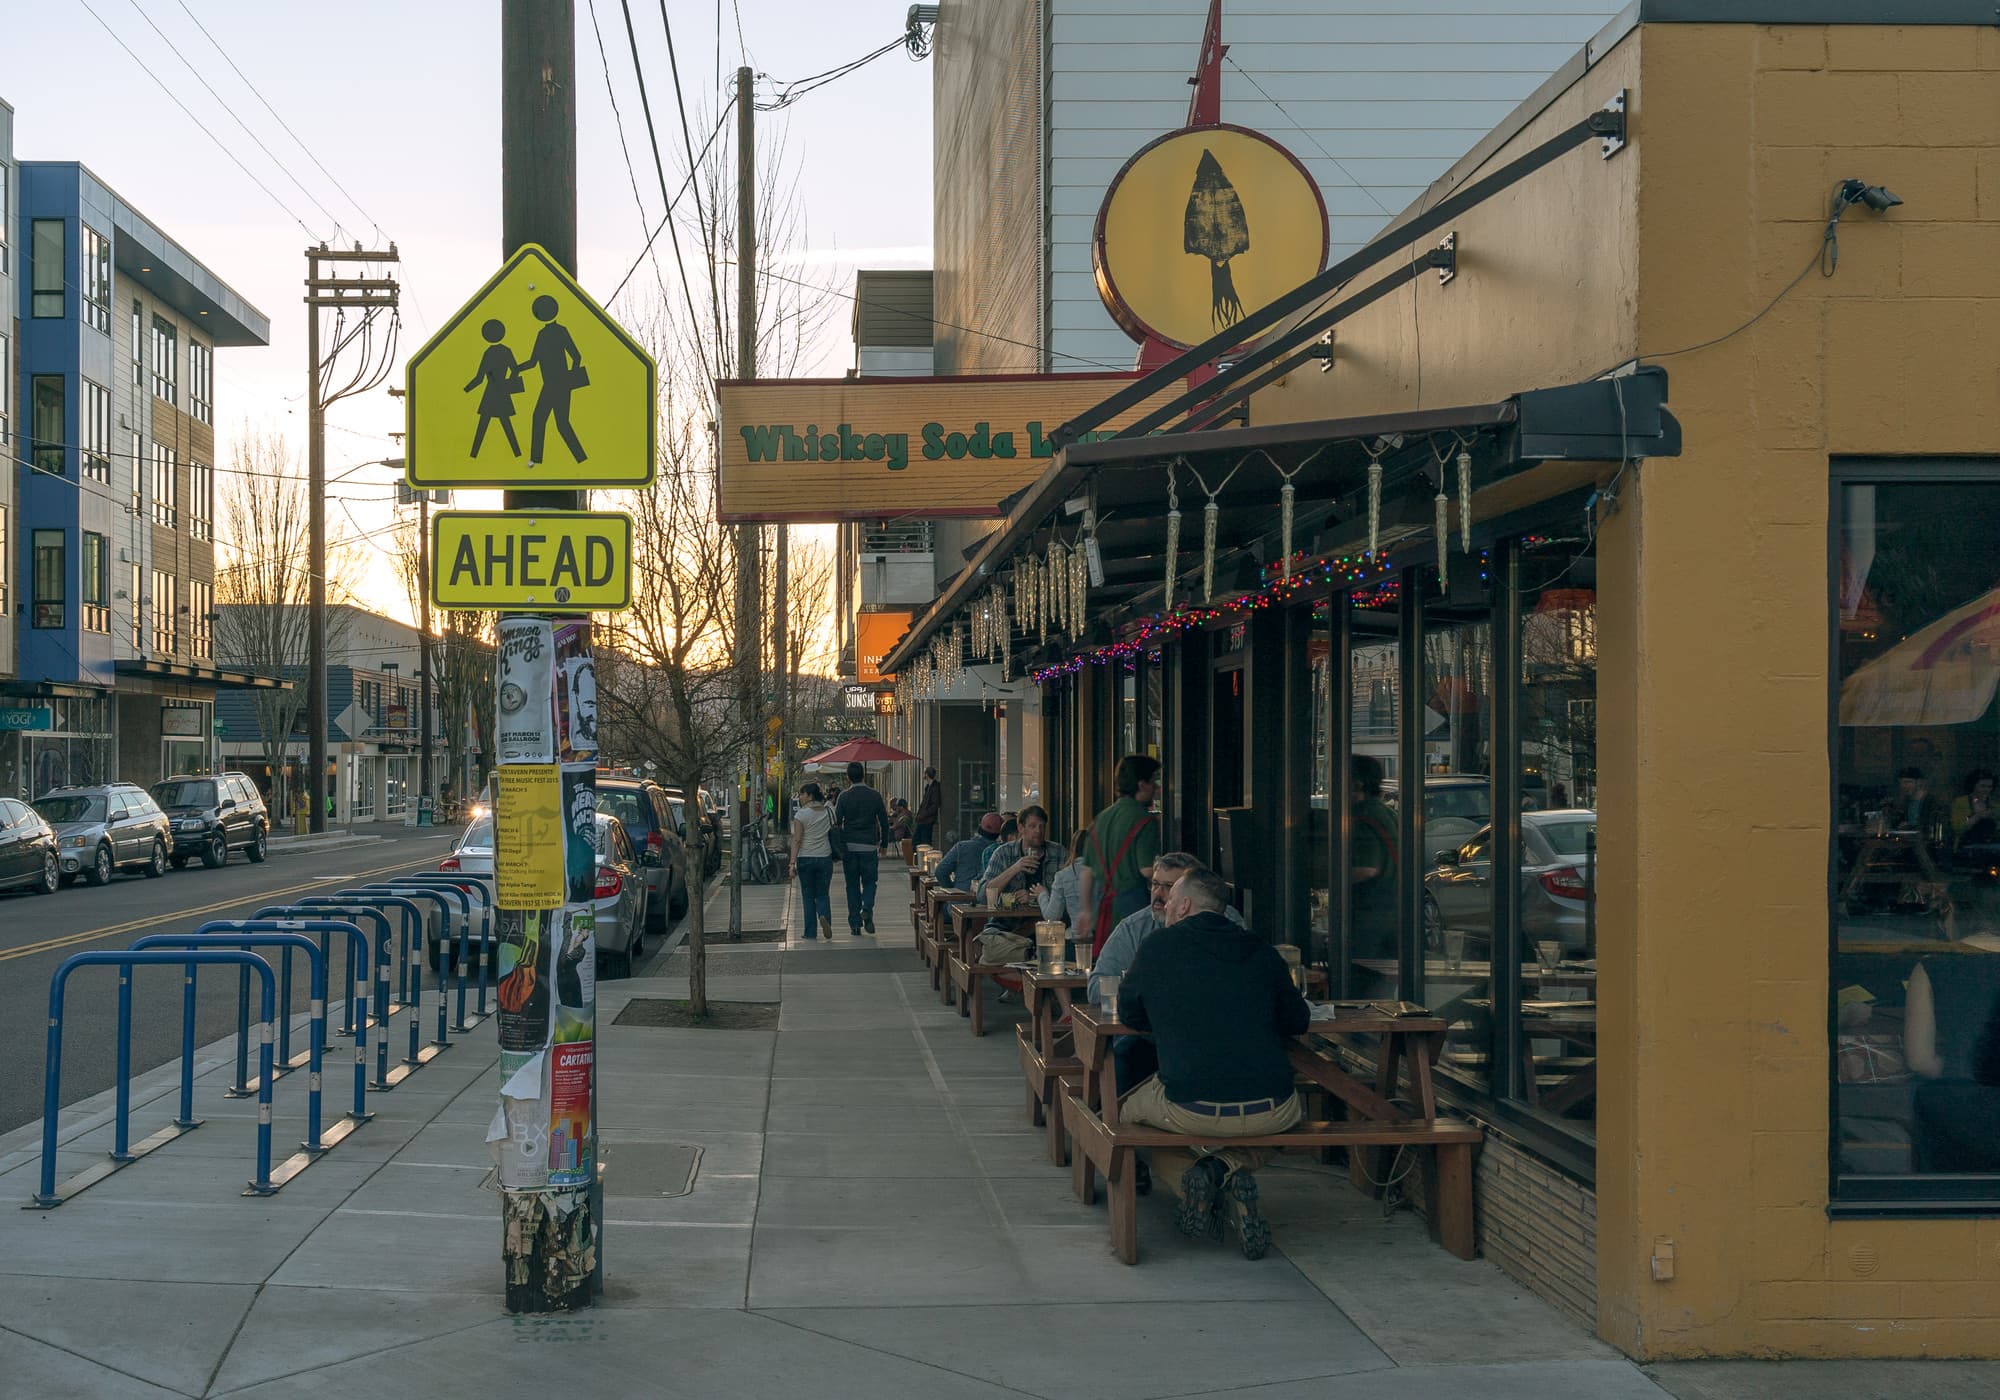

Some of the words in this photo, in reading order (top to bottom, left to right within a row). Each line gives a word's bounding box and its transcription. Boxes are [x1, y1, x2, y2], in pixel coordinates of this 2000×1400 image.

[739, 424, 908, 470] Whiskey
[921, 422, 1017, 460] Soda
[448, 533, 615, 588] AHEAD
[863, 655, 883, 664] INH
[846, 693, 873, 708] SUNSH
